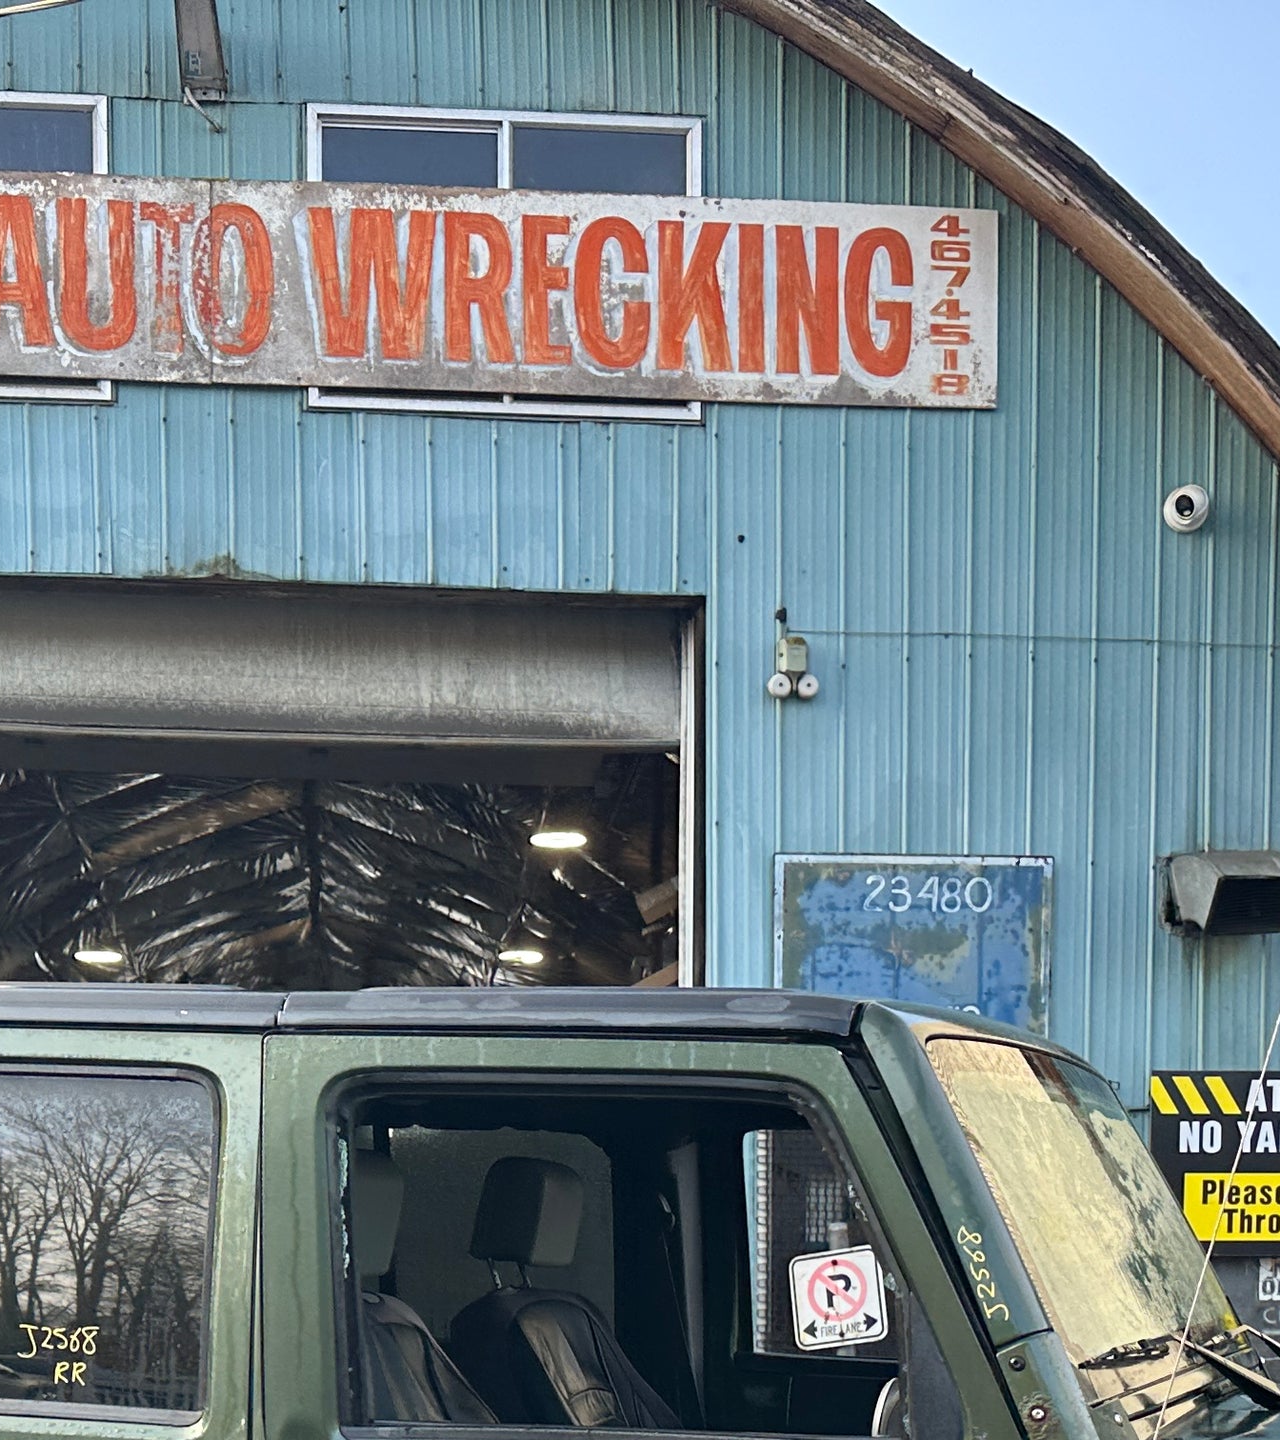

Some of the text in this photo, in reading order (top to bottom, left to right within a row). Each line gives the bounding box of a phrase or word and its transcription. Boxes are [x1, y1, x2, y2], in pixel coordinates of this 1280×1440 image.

[308, 206, 914, 380] WRECKING
[863, 875, 993, 913] 23480
[1178, 1121, 1222, 1153] NO
[957, 1225, 1010, 1322] J2568
[17, 1324, 99, 1359] J2568
[820, 1325, 839, 1337] FIRE
[53, 1361, 87, 1386] RR
